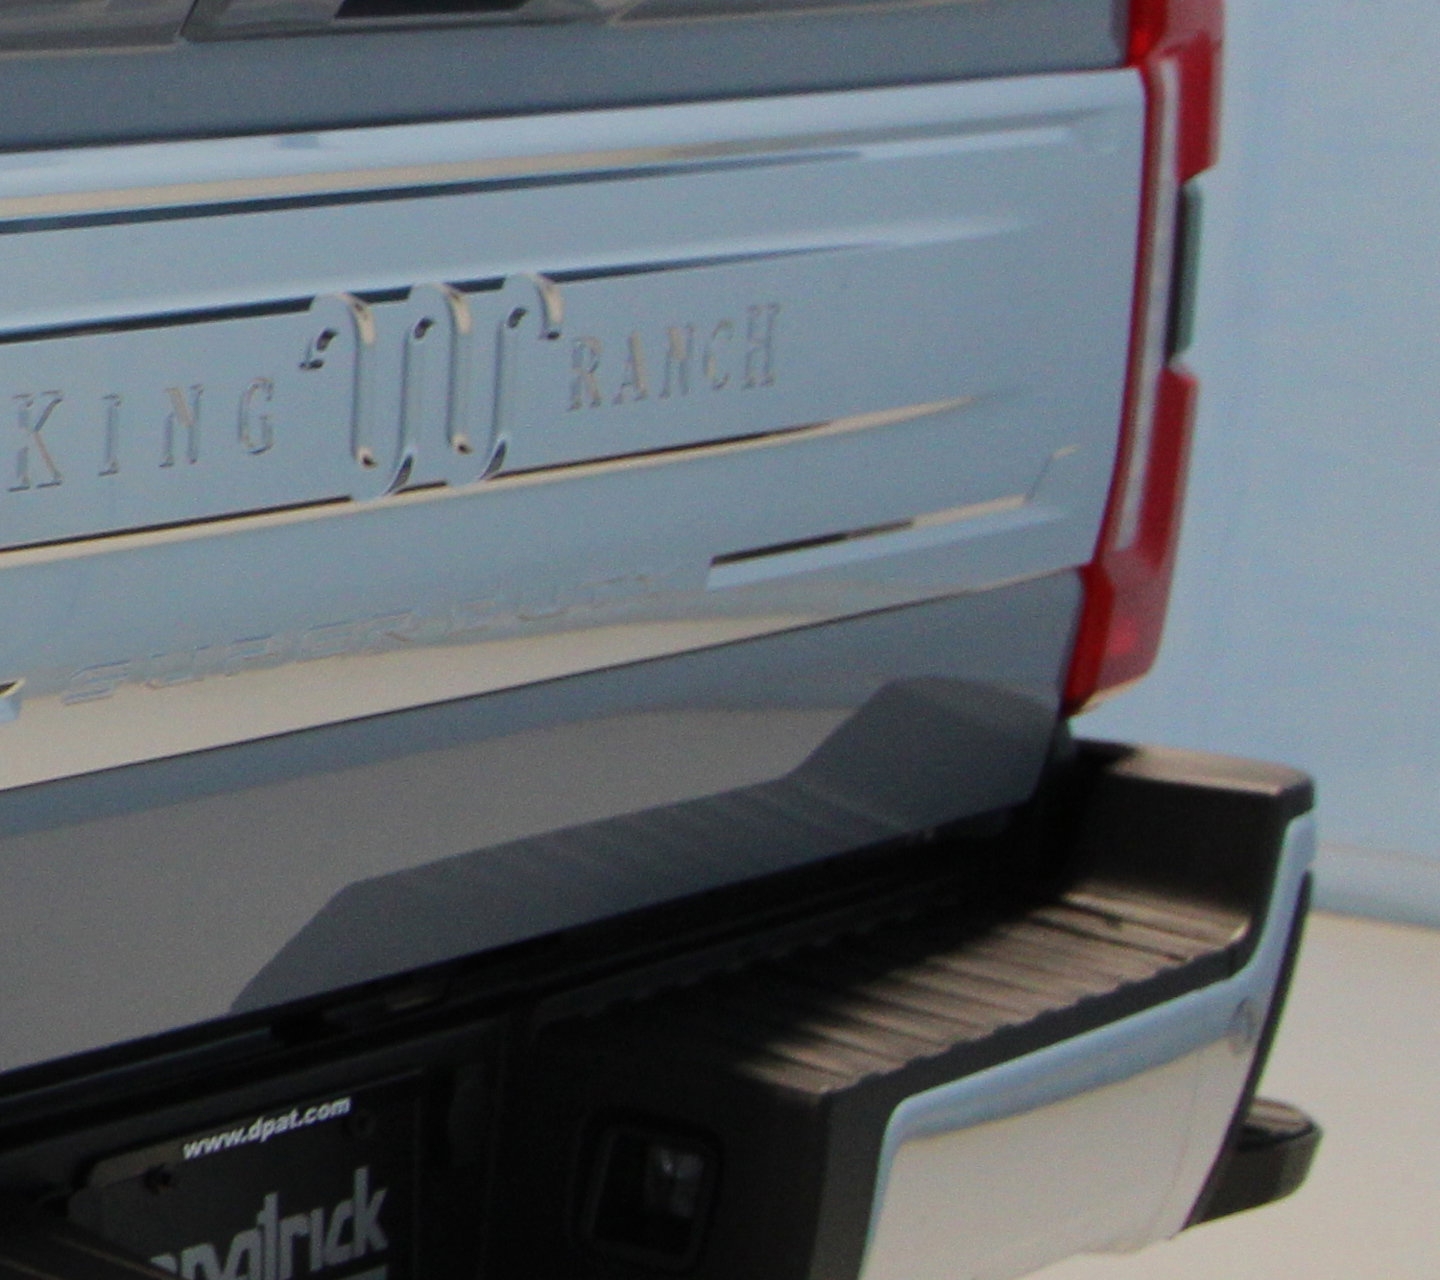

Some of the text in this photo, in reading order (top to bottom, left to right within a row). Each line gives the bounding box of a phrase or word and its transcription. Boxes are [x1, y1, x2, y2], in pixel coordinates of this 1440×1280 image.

[6, 302, 782, 493] KING RANCH
[182, 1095, 352, 1161] www.dpat.com
